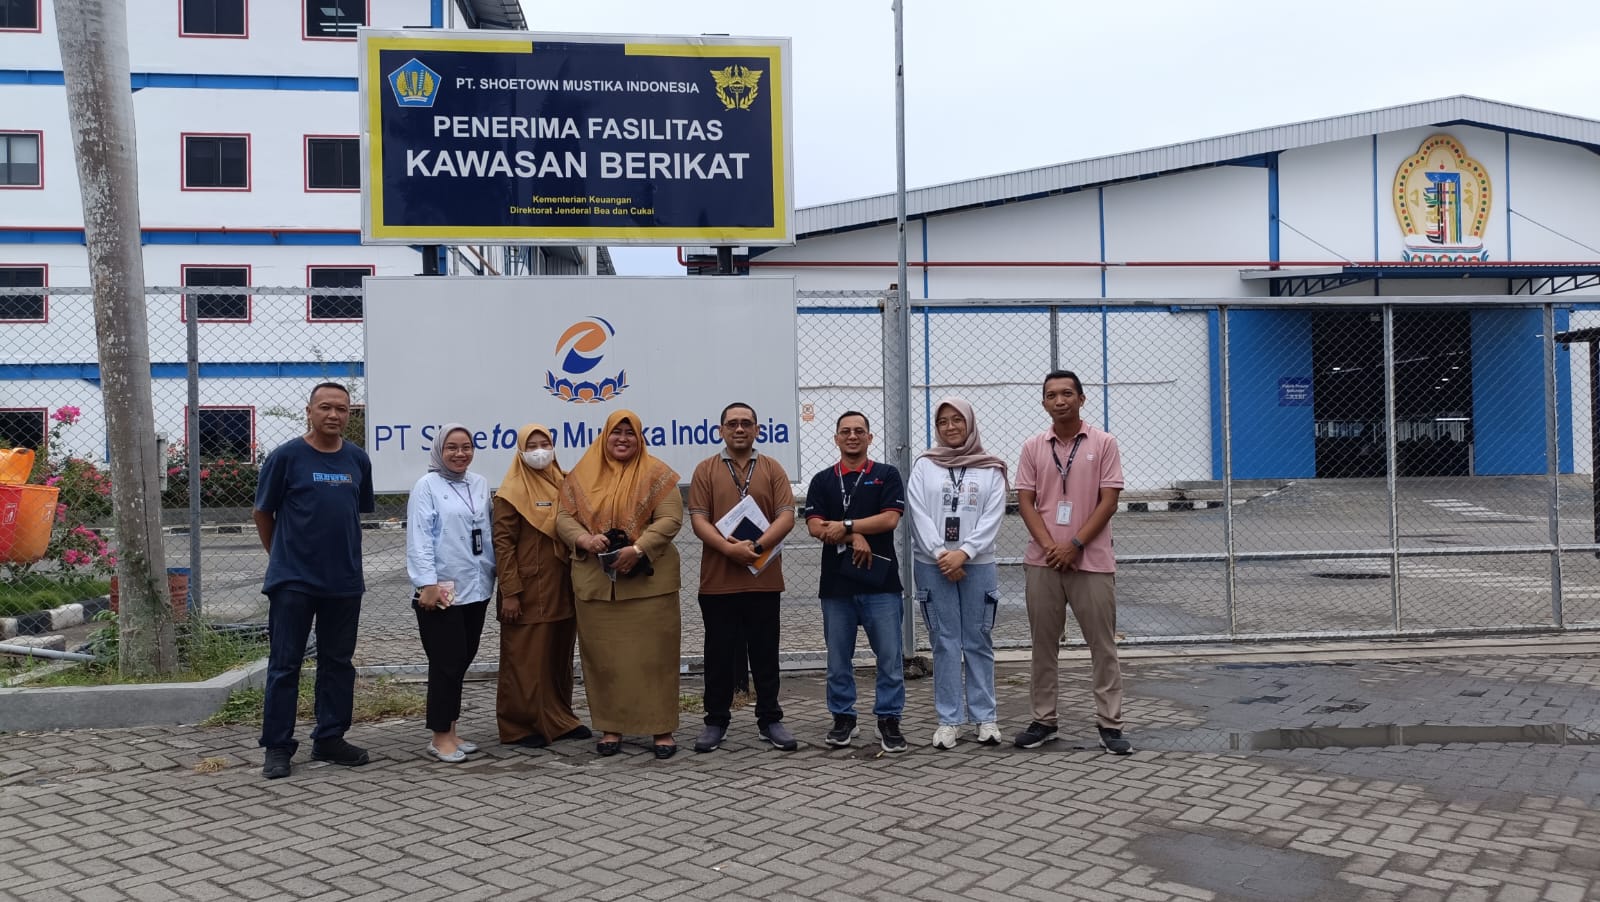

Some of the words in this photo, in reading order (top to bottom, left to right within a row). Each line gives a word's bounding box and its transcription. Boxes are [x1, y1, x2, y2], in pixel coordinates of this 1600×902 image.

[456, 78, 476, 89] PT.
[479, 78, 559, 91] SHOETOWN
[563, 80, 624, 92] MUSTIKA
[627, 81, 700, 94] INDONESIA
[433, 115, 581, 139] PENERIMA
[588, 118, 723, 141] FASILITAS
[406, 149, 588, 178] KAWASAN
[600, 152, 750, 180] BERIKAT
[510, 206, 552, 214] Direktorat
[555, 206, 592, 214] Jenderal
[594, 207, 610, 215] Bea
[612, 207, 629, 215] dan
[630, 207, 655, 215] Cukai
[532, 195, 587, 204] Kementerian
[589, 195, 632, 206] Keuangan
[375, 425, 412, 451] PT
[672, 417, 790, 446] Indosia
